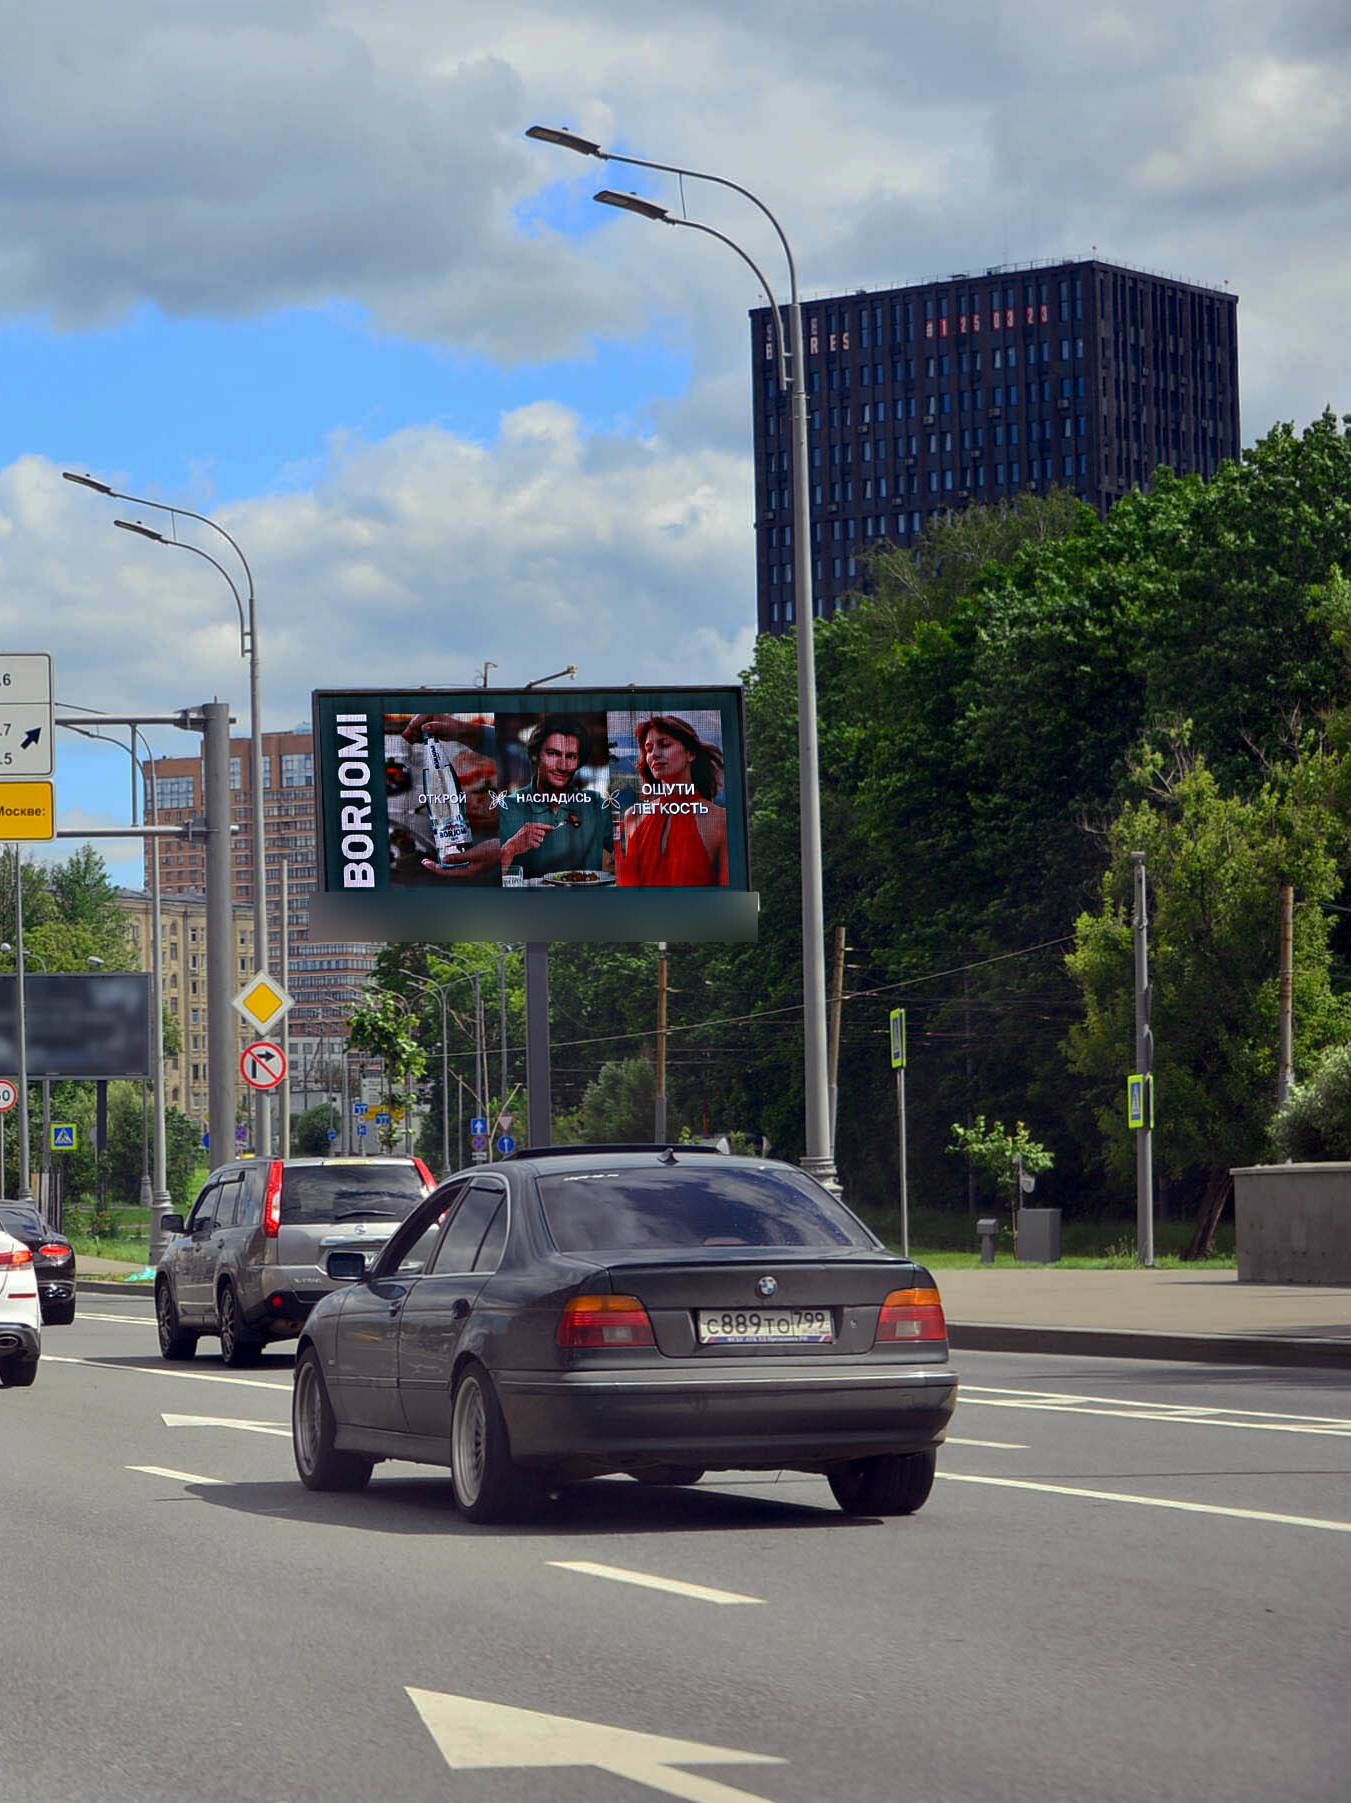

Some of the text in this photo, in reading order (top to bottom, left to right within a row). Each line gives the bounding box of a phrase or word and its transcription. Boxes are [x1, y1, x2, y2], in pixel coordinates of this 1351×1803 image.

[641, 783, 696, 797] ОЩУТИ
[336, 713, 376, 888] BORJOMI
[418, 791, 467, 804] ОТКРОЙ
[516, 792, 592, 804] НАСЛАДИСЬ
[632, 798, 710, 815] ЛЁГКОСТЬ
